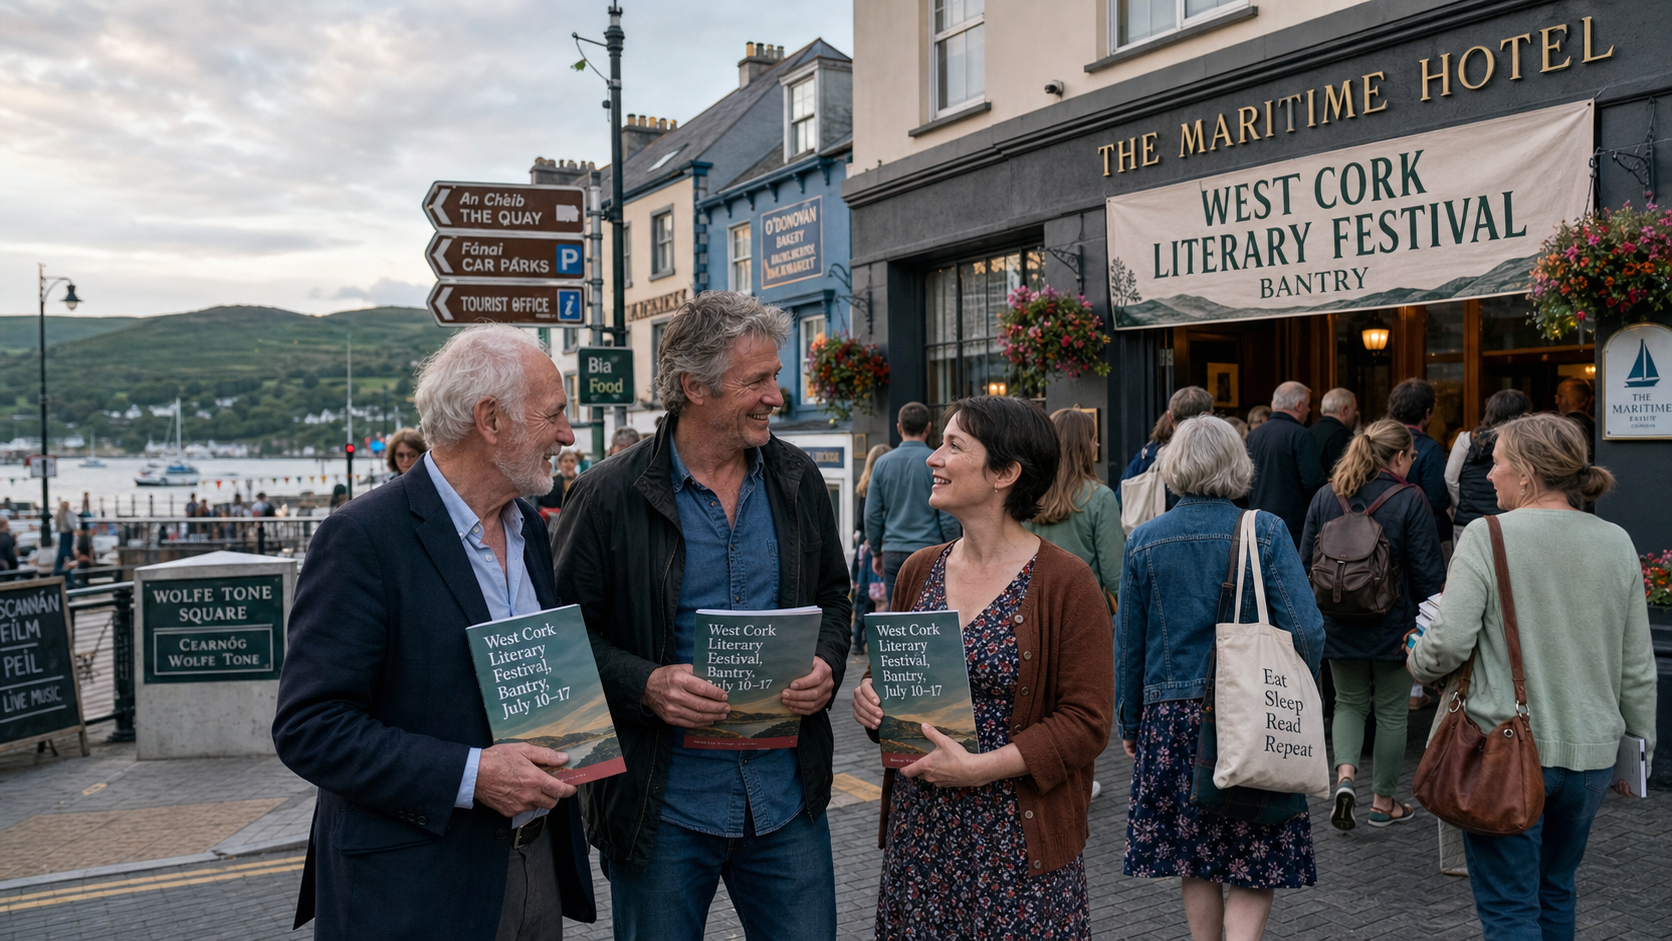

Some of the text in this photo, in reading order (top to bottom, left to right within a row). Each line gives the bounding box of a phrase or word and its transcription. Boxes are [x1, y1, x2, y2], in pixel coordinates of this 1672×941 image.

[1097, 16, 1616, 177] THE MARITIME HOTEL
[1201, 149, 1427, 227] WEST CORK
[459, 192, 479, 205] An
[459, 209, 542, 226] THE QUAY
[1153, 190, 1527, 280] LITERARY FESTIVAL
[462, 258, 495, 272] CAR
[561, 248, 579, 271] P
[1259, 266, 1370, 300] BANTRY
[460, 296, 509, 312] TOURIST
[588, 356, 612, 374] Bia
[589, 377, 624, 394] Food
[1631, 393, 1652, 402] THE
[1612, 403, 1672, 414] MARITIME
[153, 585, 273, 604] WOLFE TONE
[179, 606, 248, 624] SQUARE
[483, 622, 557, 649] West Cork
[708, 623, 777, 637] West Cork
[875, 623, 940, 637] West Cork
[707, 637, 764, 654] Literary
[878, 639, 928, 654] Literary
[168, 652, 260, 668] WOLFE TONE
[488, 644, 546, 667] Literary
[880, 654, 931, 669] Festival,
[492, 658, 553, 684] Festival,
[882, 669, 927, 684] Bantry,
[1263, 668, 1288, 688] Eat
[31, 685, 63, 706] MUSIC
[497, 678, 550, 701] Bantry,
[884, 685, 907, 700] July
[501, 699, 531, 720] July
[1264, 690, 1304, 716] Sleep
[1265, 712, 1302, 734] Read
[1264, 735, 1313, 759] Repeat
